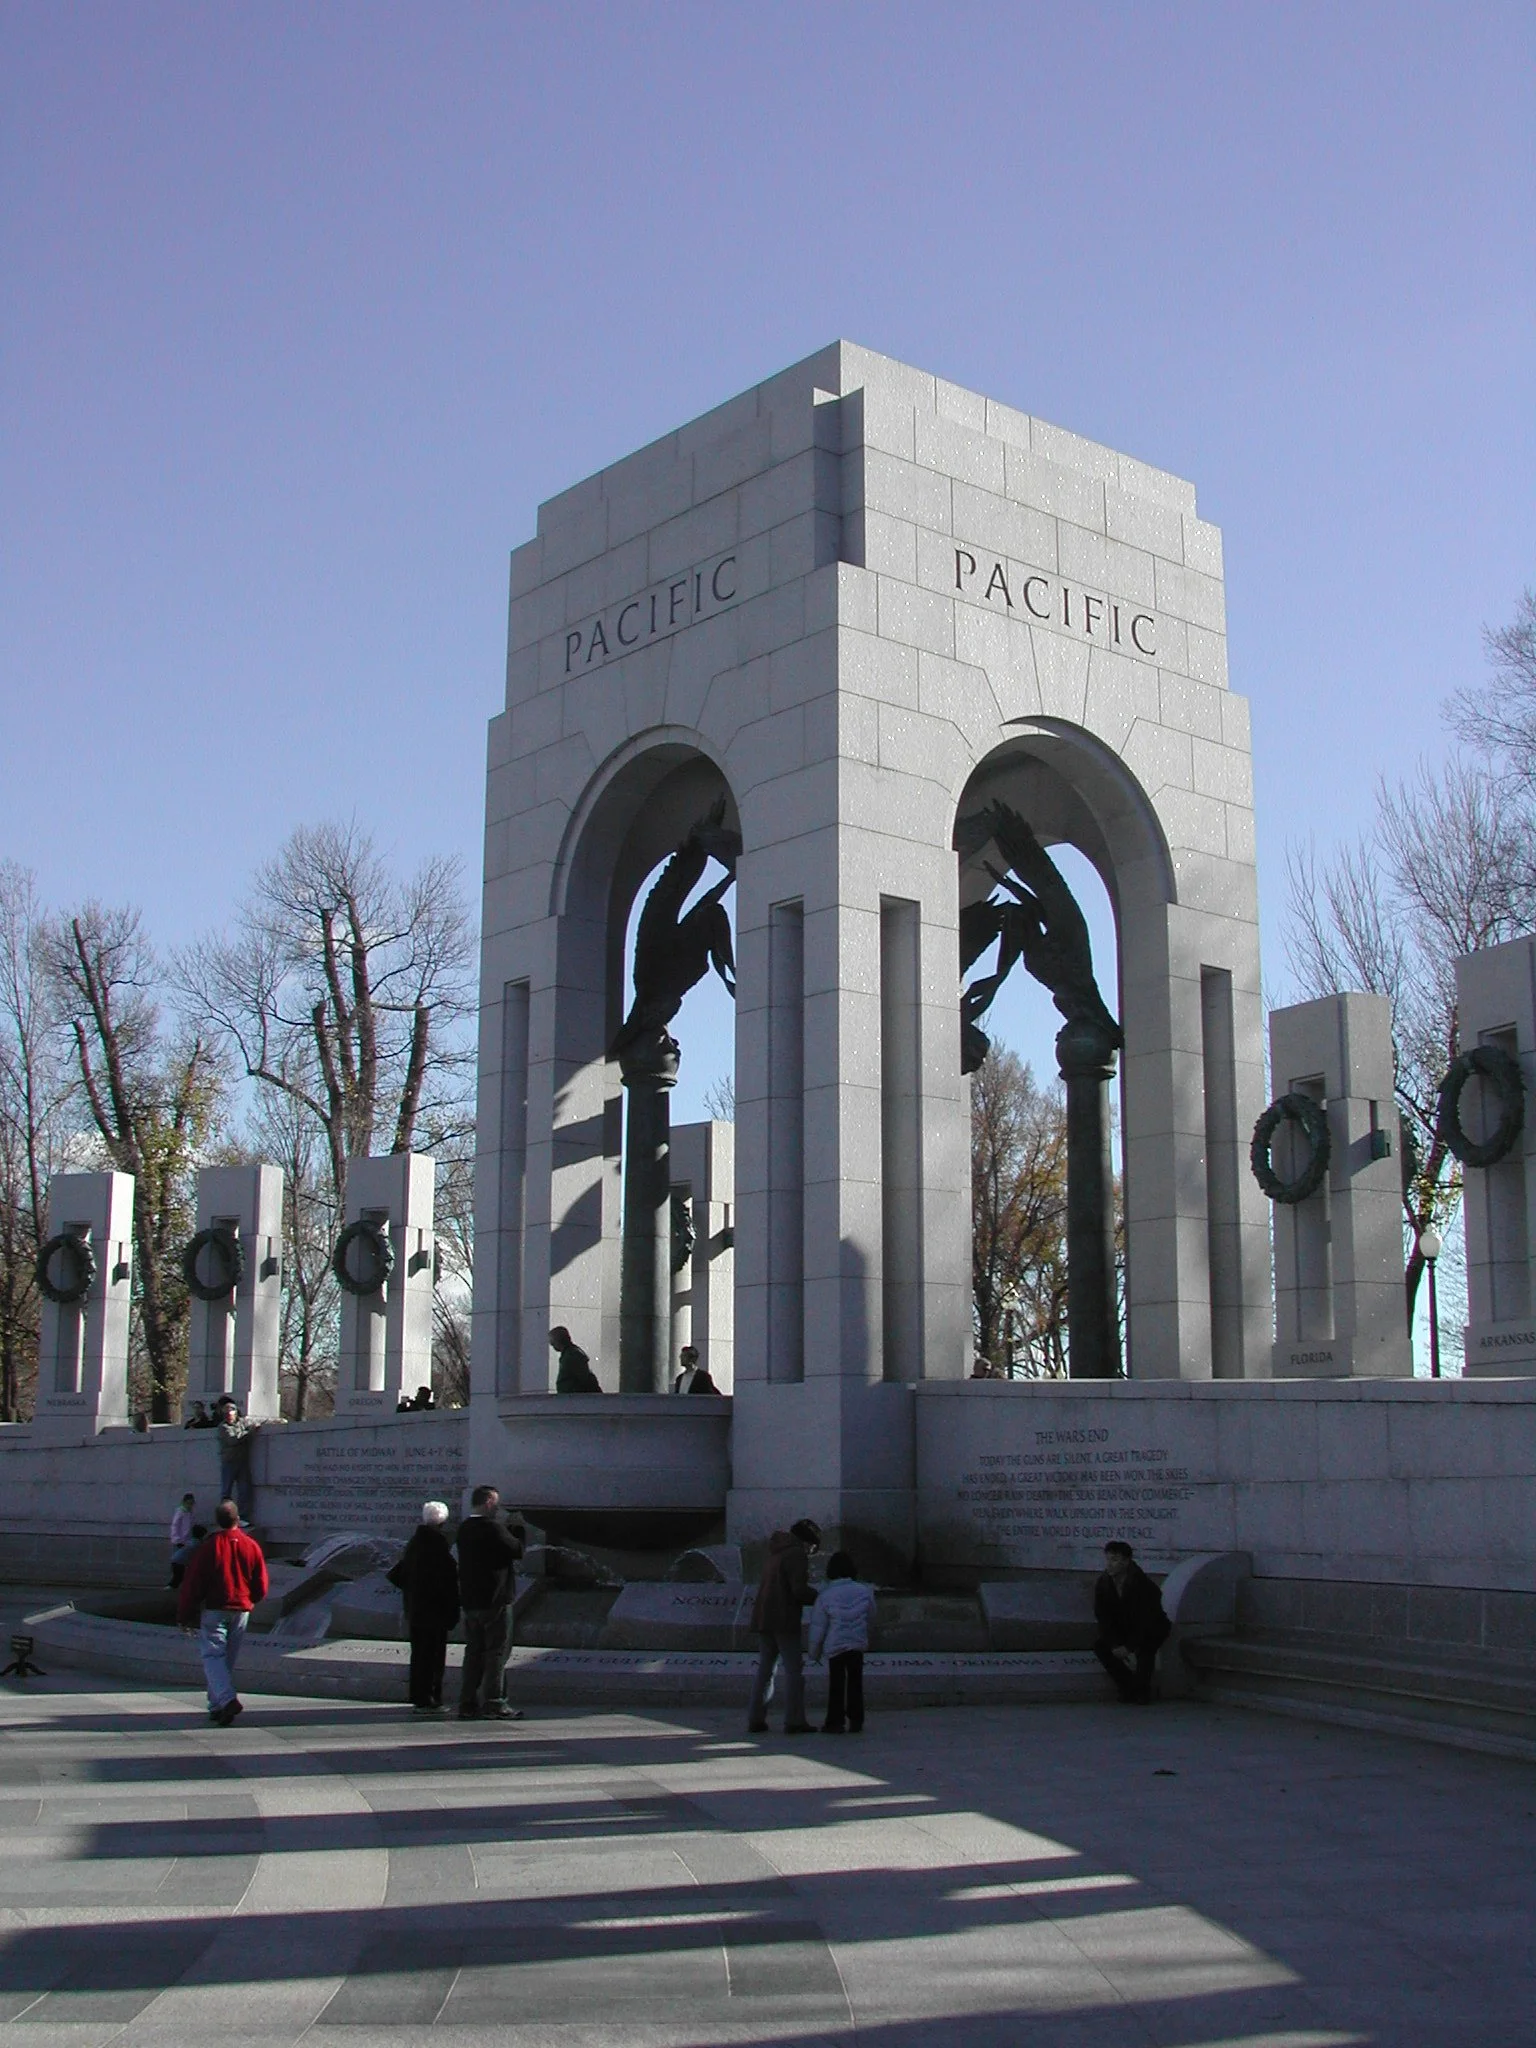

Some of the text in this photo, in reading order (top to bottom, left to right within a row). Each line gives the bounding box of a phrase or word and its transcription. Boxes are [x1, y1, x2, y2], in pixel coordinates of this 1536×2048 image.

[953, 547, 1157, 656] PACIFIC
[564, 555, 737, 674] PACIFIC
[1479, 1331, 1535, 1348] ARKANSAS
[1290, 1351, 1334, 1365] FLORIDA
[46, 1399, 88, 1407] NEBRASKA
[348, 1398, 384, 1406] OREGON
[1035, 1431, 1054, 1444] THE
[1088, 1428, 1109, 1443] END
[316, 1447, 345, 1457] BATTLE
[347, 1447, 360, 1457] OF
[361, 1447, 396, 1457] MIDWAY
[404, 1447, 427, 1457] JUNE
[979, 1455, 1004, 1466] TODAY
[1006, 1455, 1021, 1466] THE
[1023, 1454, 1045, 1465] GUNS
[1103, 1452, 1128, 1463] GREAT
[1131, 1450, 1169, 1462] TRAGEDY
[1017, 1472, 1043, 1483] GREAT
[1045, 1471, 1078, 1483] VICTORY
[1080, 1471, 1098, 1482] HAS
[1100, 1470, 1121, 1482] BEEN
[1147, 1469, 1163, 1481] THE
[1165, 1468, 1189, 1480] SKIES
[1076, 1490, 1095, 1501] SEAS
[1097, 1489, 1118, 1501] BEAR
[1119, 1489, 1140, 1501] ONLY
[1045, 1508, 1069, 1519] WALK
[1071, 1508, 1105, 1519] UPRIGHT
[1118, 1508, 1135, 1519] THE
[1013, 1526, 1041, 1537] ENTIRE
[1042, 1526, 1071, 1537] WORLD
[1081, 1526, 1115, 1538] QUIETLY
[1117, 1526, 1127, 1538] AT
[672, 1597, 737, 1606] NORTH
[664, 1658, 729, 1666] LUZON
[952, 1659, 1043, 1667] OKINAWA
